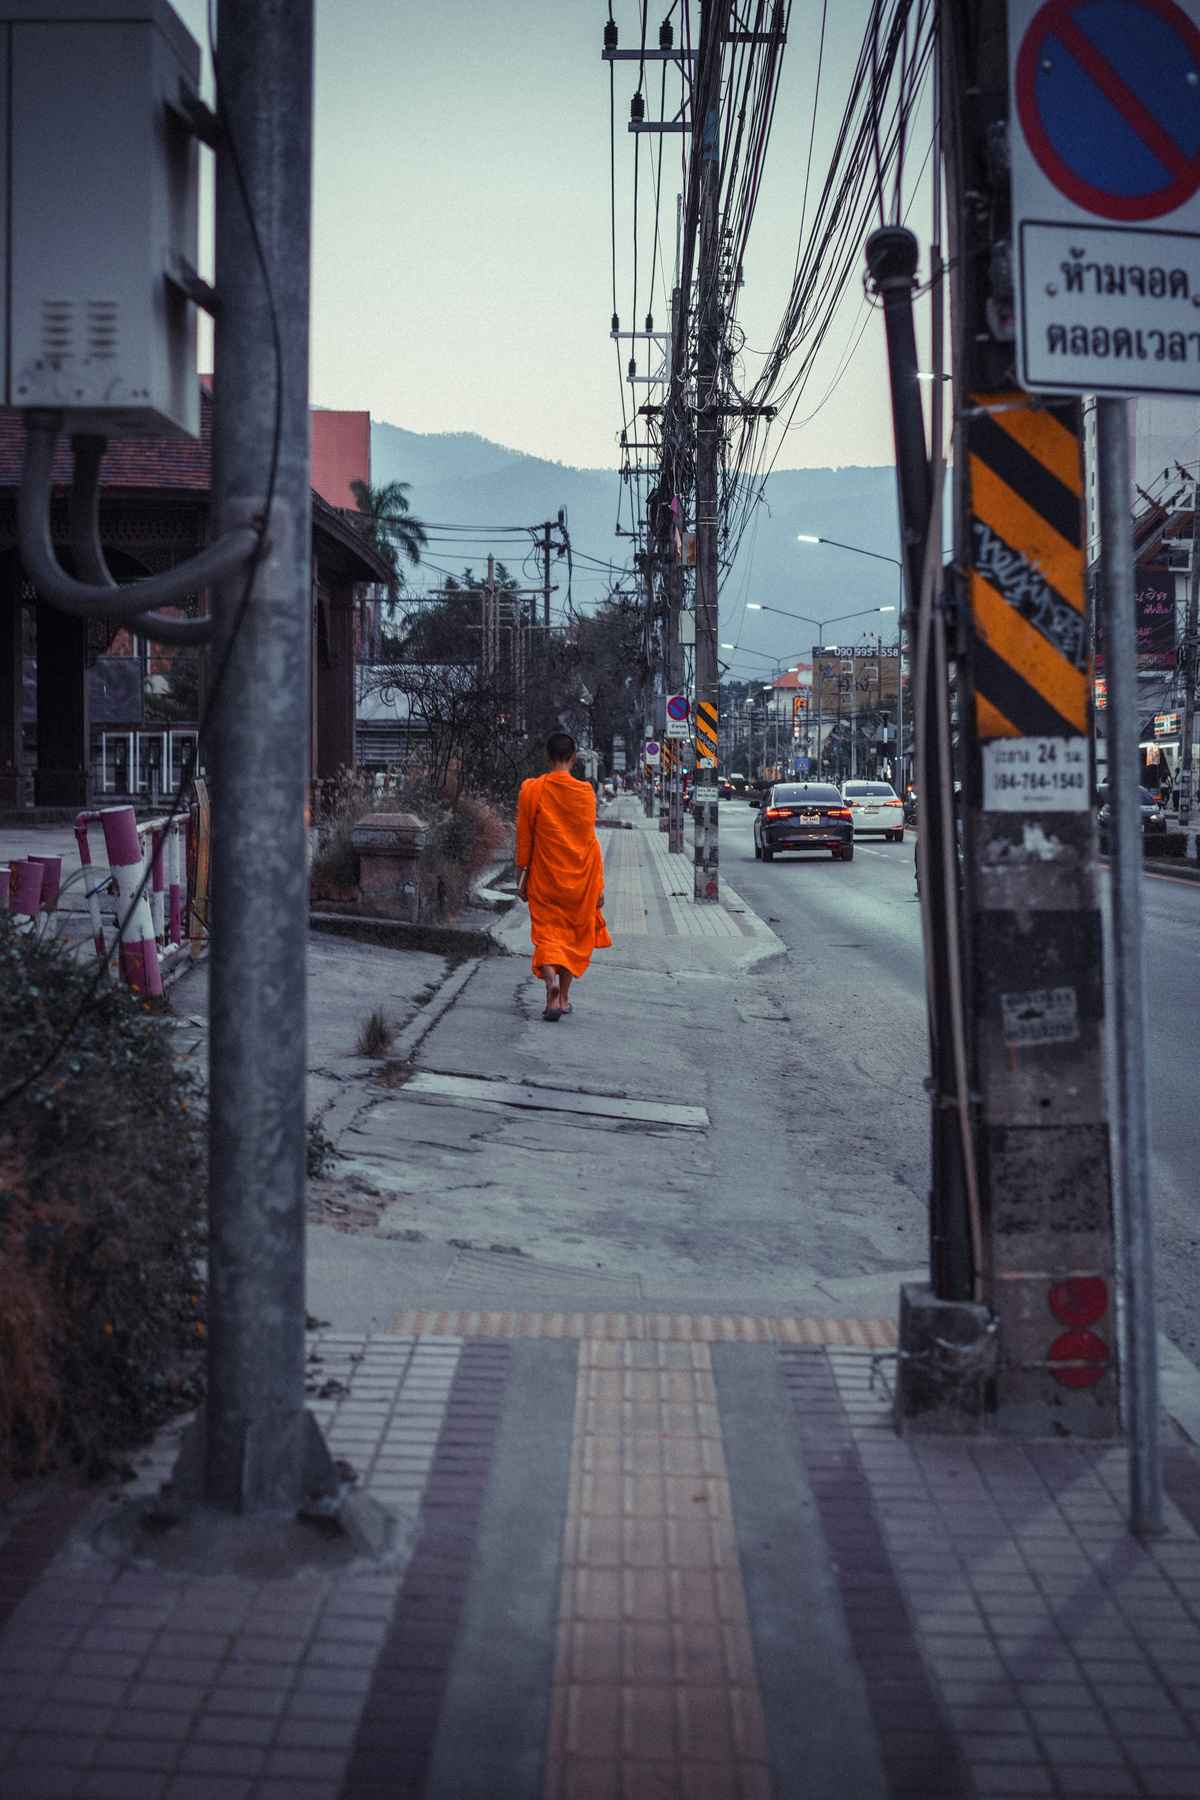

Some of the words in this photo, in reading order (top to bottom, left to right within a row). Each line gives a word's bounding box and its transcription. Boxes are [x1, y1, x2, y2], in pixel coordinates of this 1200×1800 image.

[1060, 246, 1189, 300] ห้ามจอด
[1046, 323, 1200, 362] ตลอดเวลา
[834, 647, 853, 656] 090
[1037, 743, 1057, 764] 24
